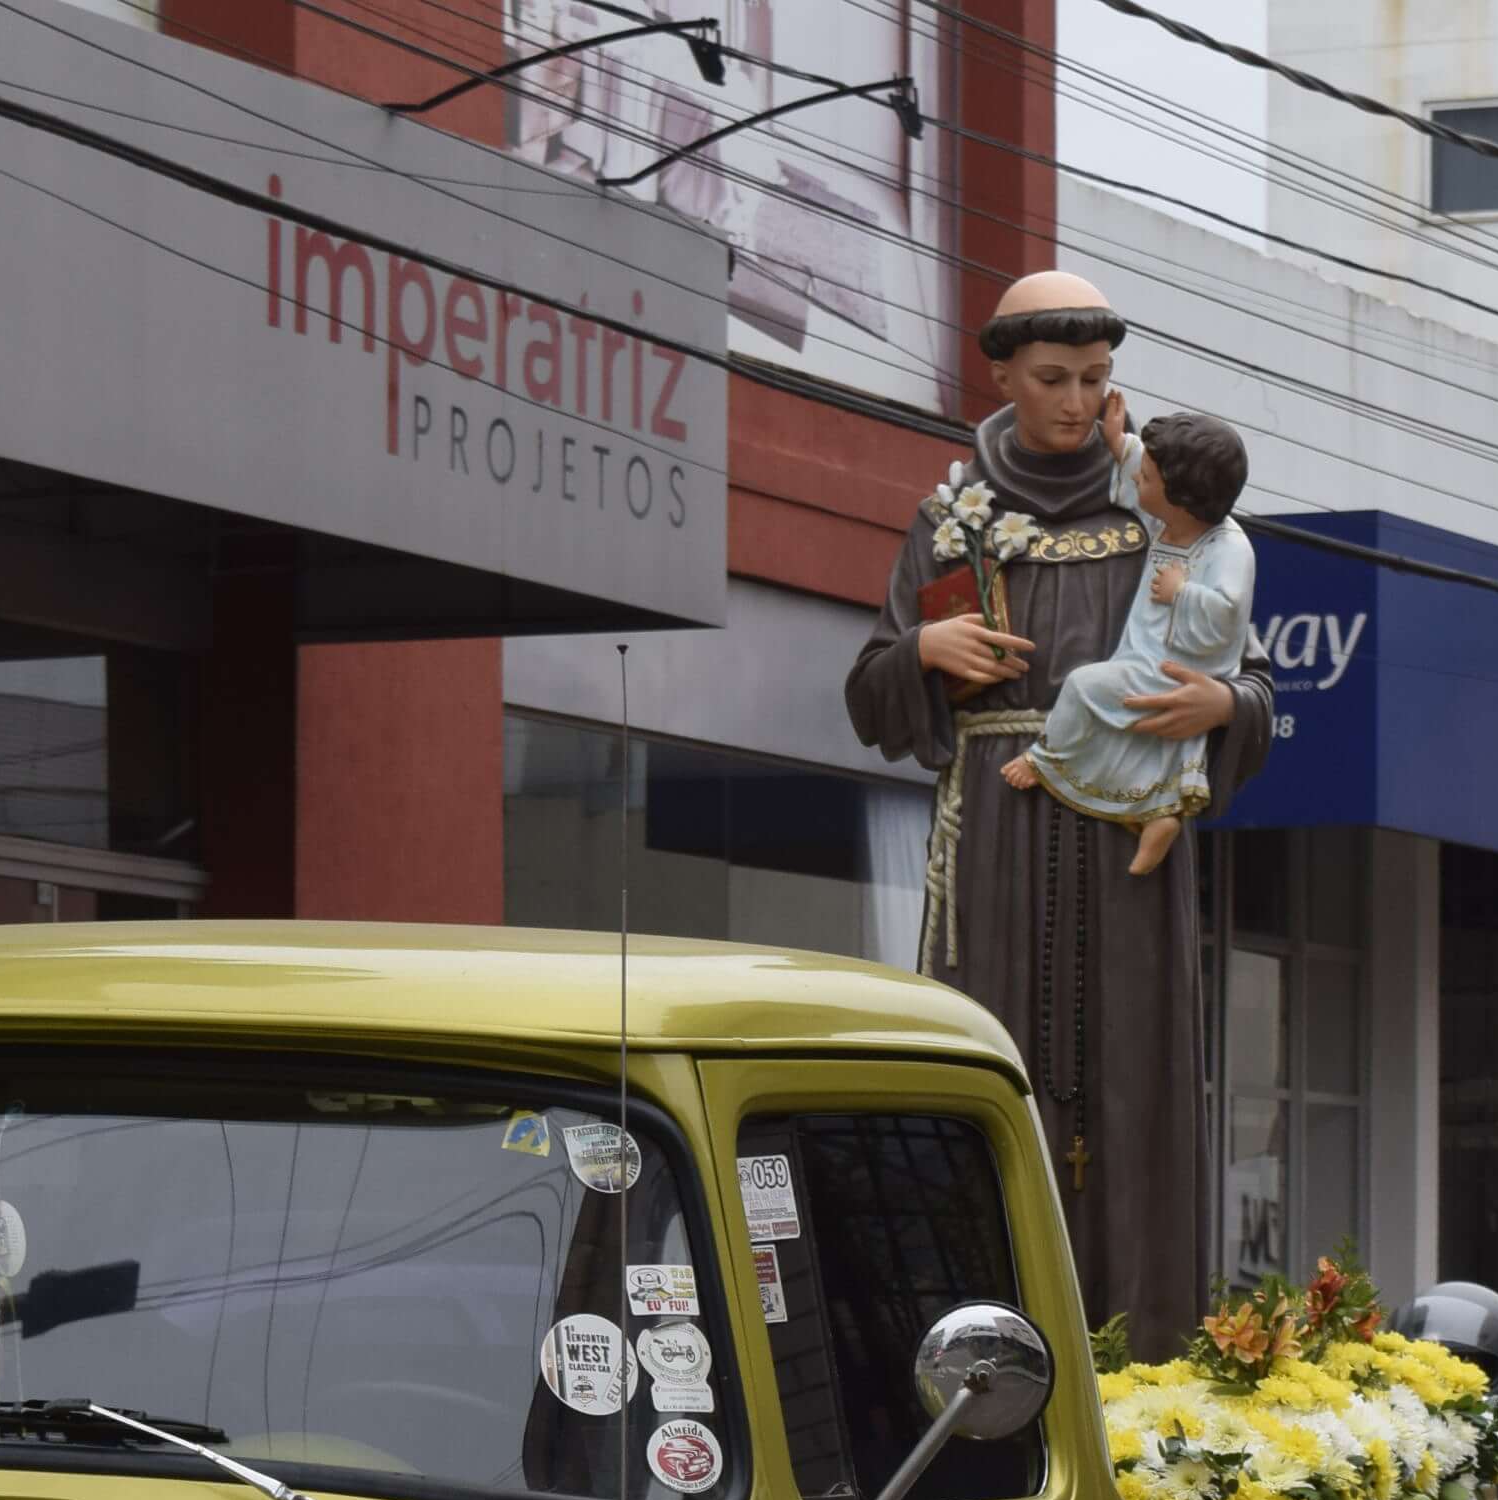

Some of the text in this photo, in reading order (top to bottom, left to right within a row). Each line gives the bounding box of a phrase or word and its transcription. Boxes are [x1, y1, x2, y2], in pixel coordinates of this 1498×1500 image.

[266, 172, 688, 457] imperatriz
[413, 394, 686, 530] PROJETOS
[751, 1157, 789, 1190] 059
[646, 1300, 690, 1312] EU FUI!
[566, 1343, 610, 1364] WEST
[568, 1361, 612, 1374] CLASSIC CAR
